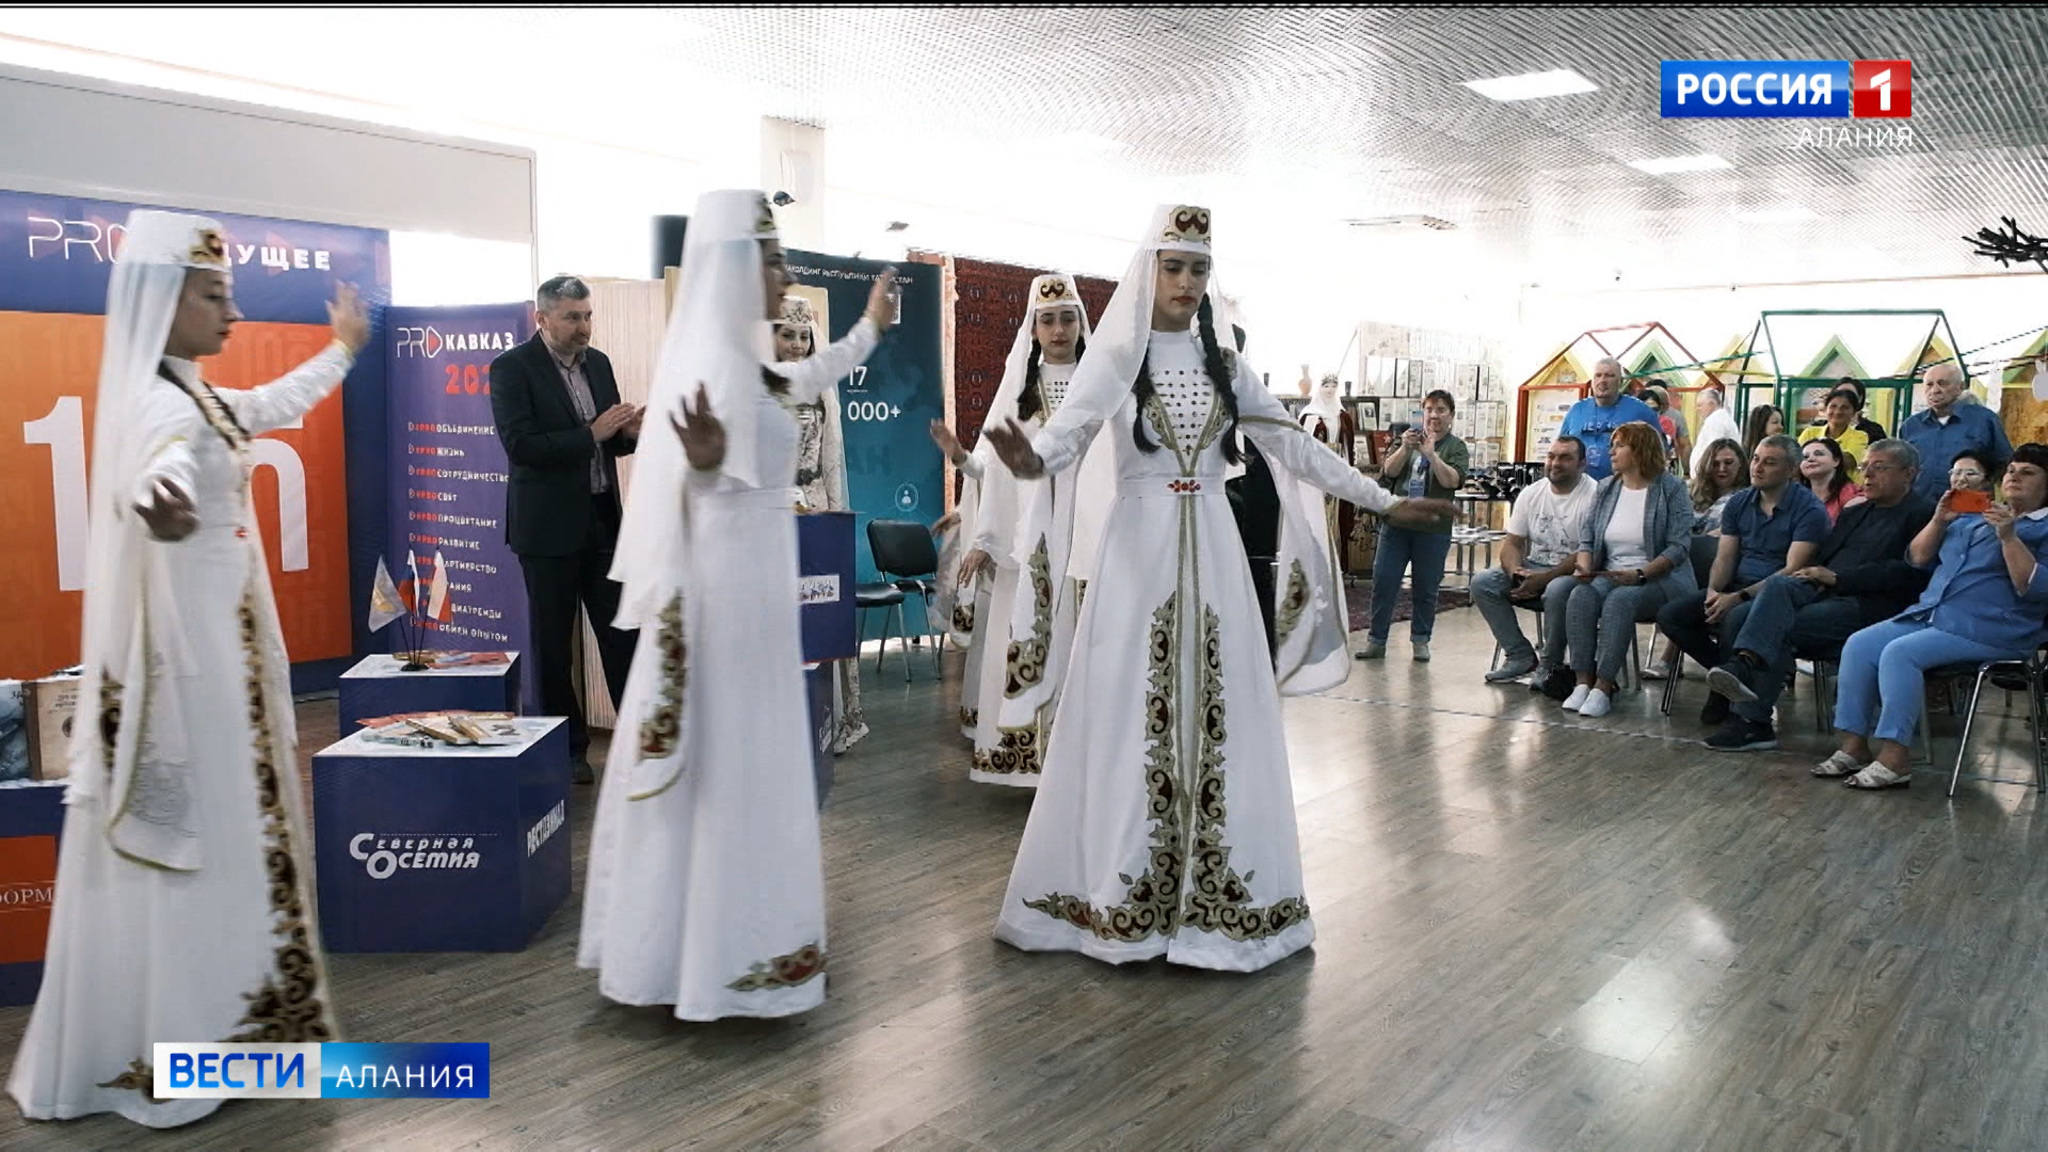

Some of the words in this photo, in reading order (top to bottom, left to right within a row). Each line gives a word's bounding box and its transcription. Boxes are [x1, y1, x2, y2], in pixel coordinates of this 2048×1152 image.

[222, 243, 331, 271] УЩЕЕ
[445, 332, 514, 351] КАВКАЗ
[445, 364, 491, 395] 202
